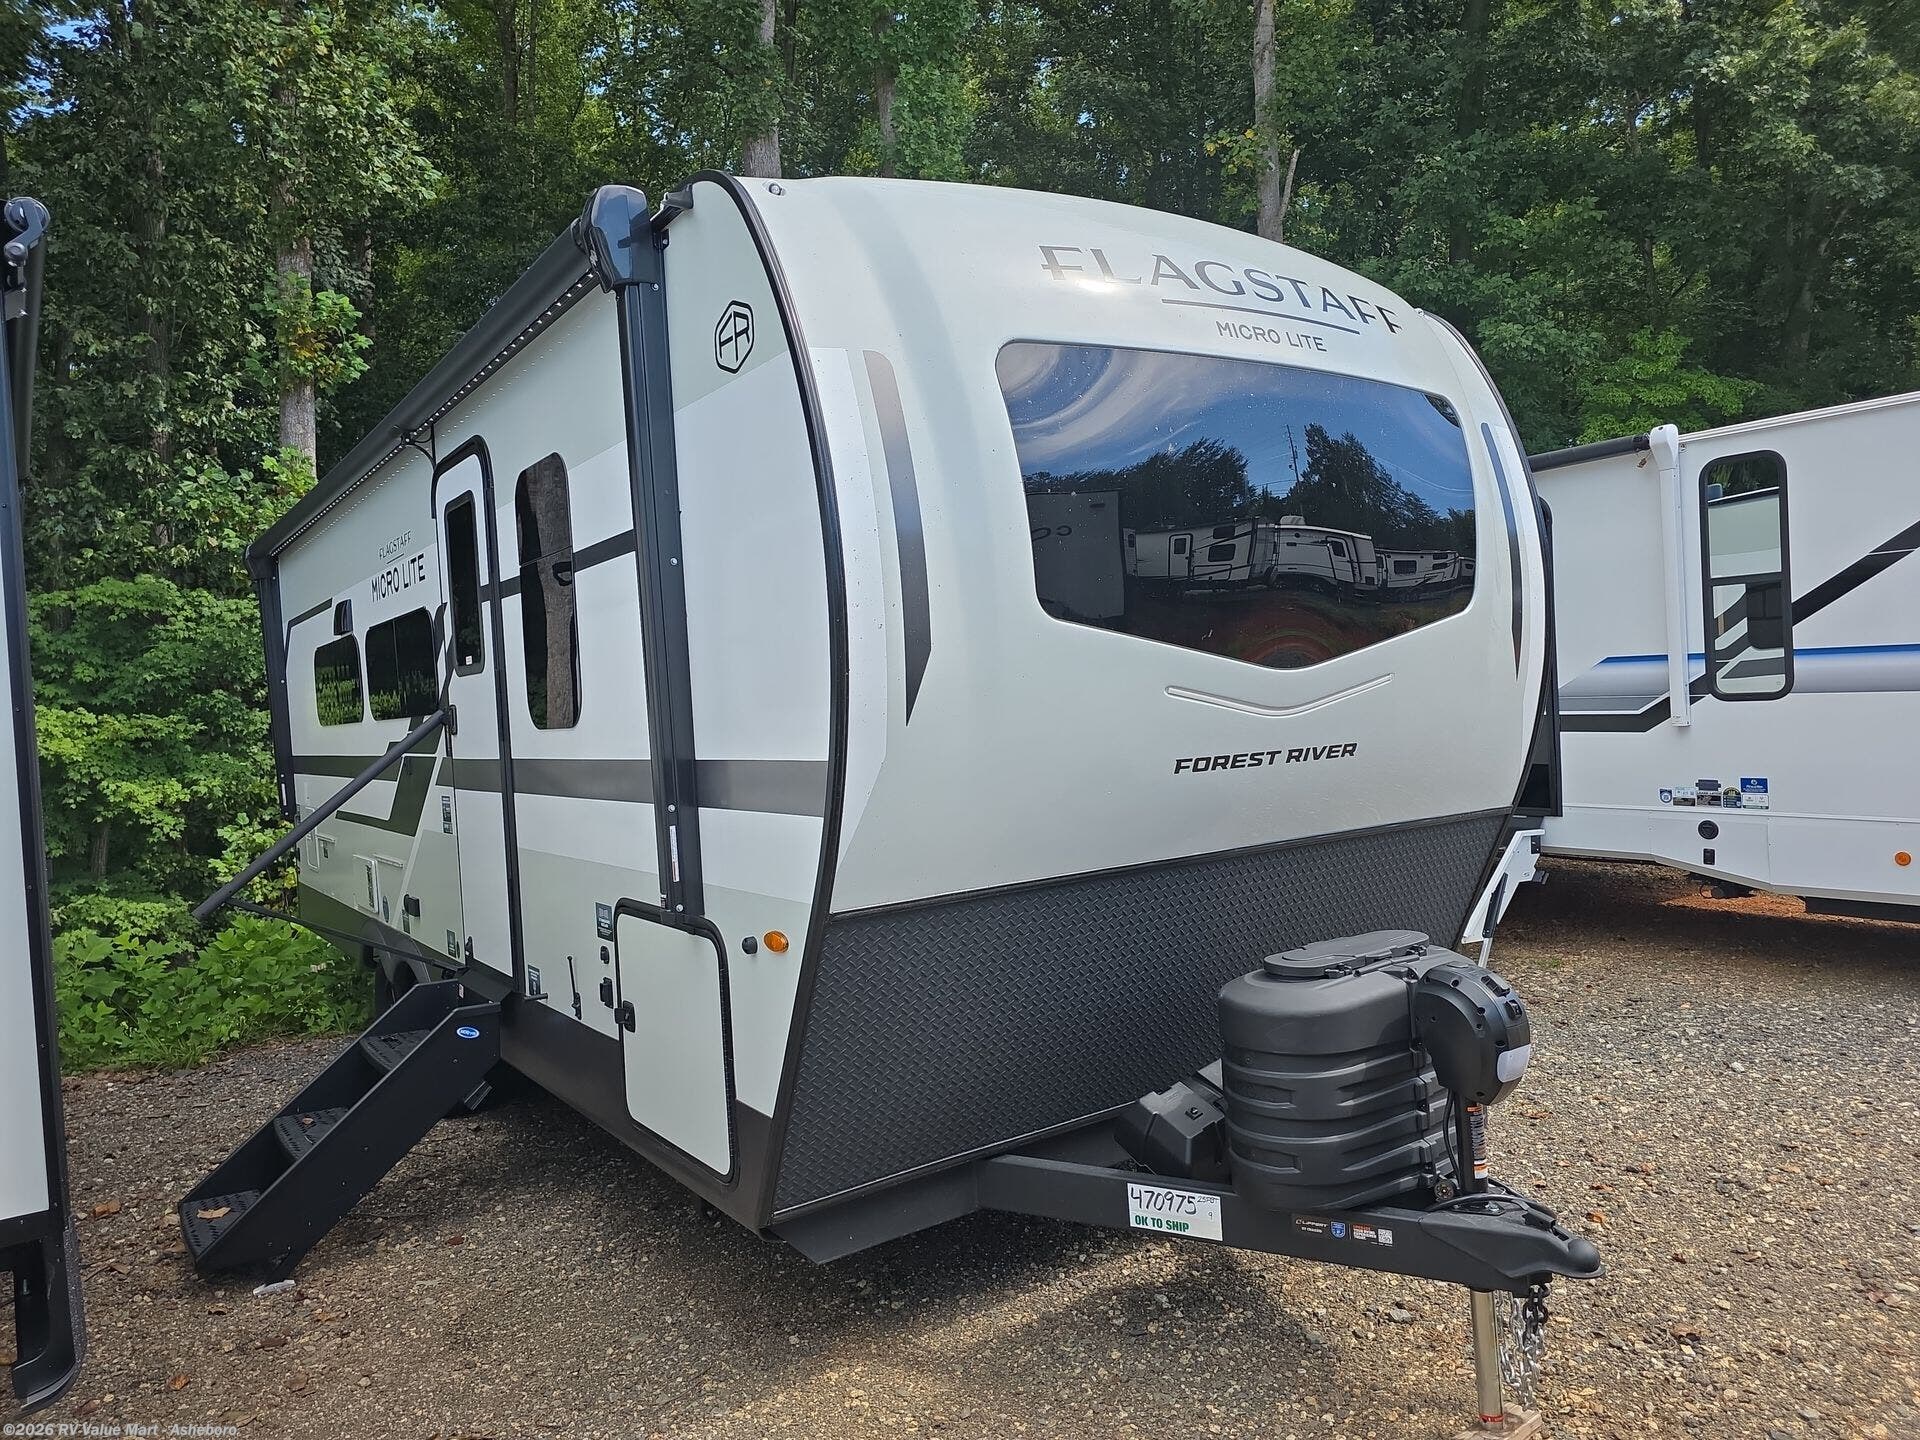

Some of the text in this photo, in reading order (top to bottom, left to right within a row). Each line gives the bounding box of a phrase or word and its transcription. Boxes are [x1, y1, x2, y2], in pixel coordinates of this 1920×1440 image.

[1038, 244, 1403, 334] FLAGSTAFF
[1216, 320, 1328, 352] MICRO LITE
[379, 530, 412, 559] FLAGSTAFF
[371, 553, 426, 602] MICRO LITE
[1173, 742, 1358, 775] FOREST RIVER
[1130, 1187, 1197, 1215] 470975
[1134, 1214, 1190, 1233] OK TO SHIP
